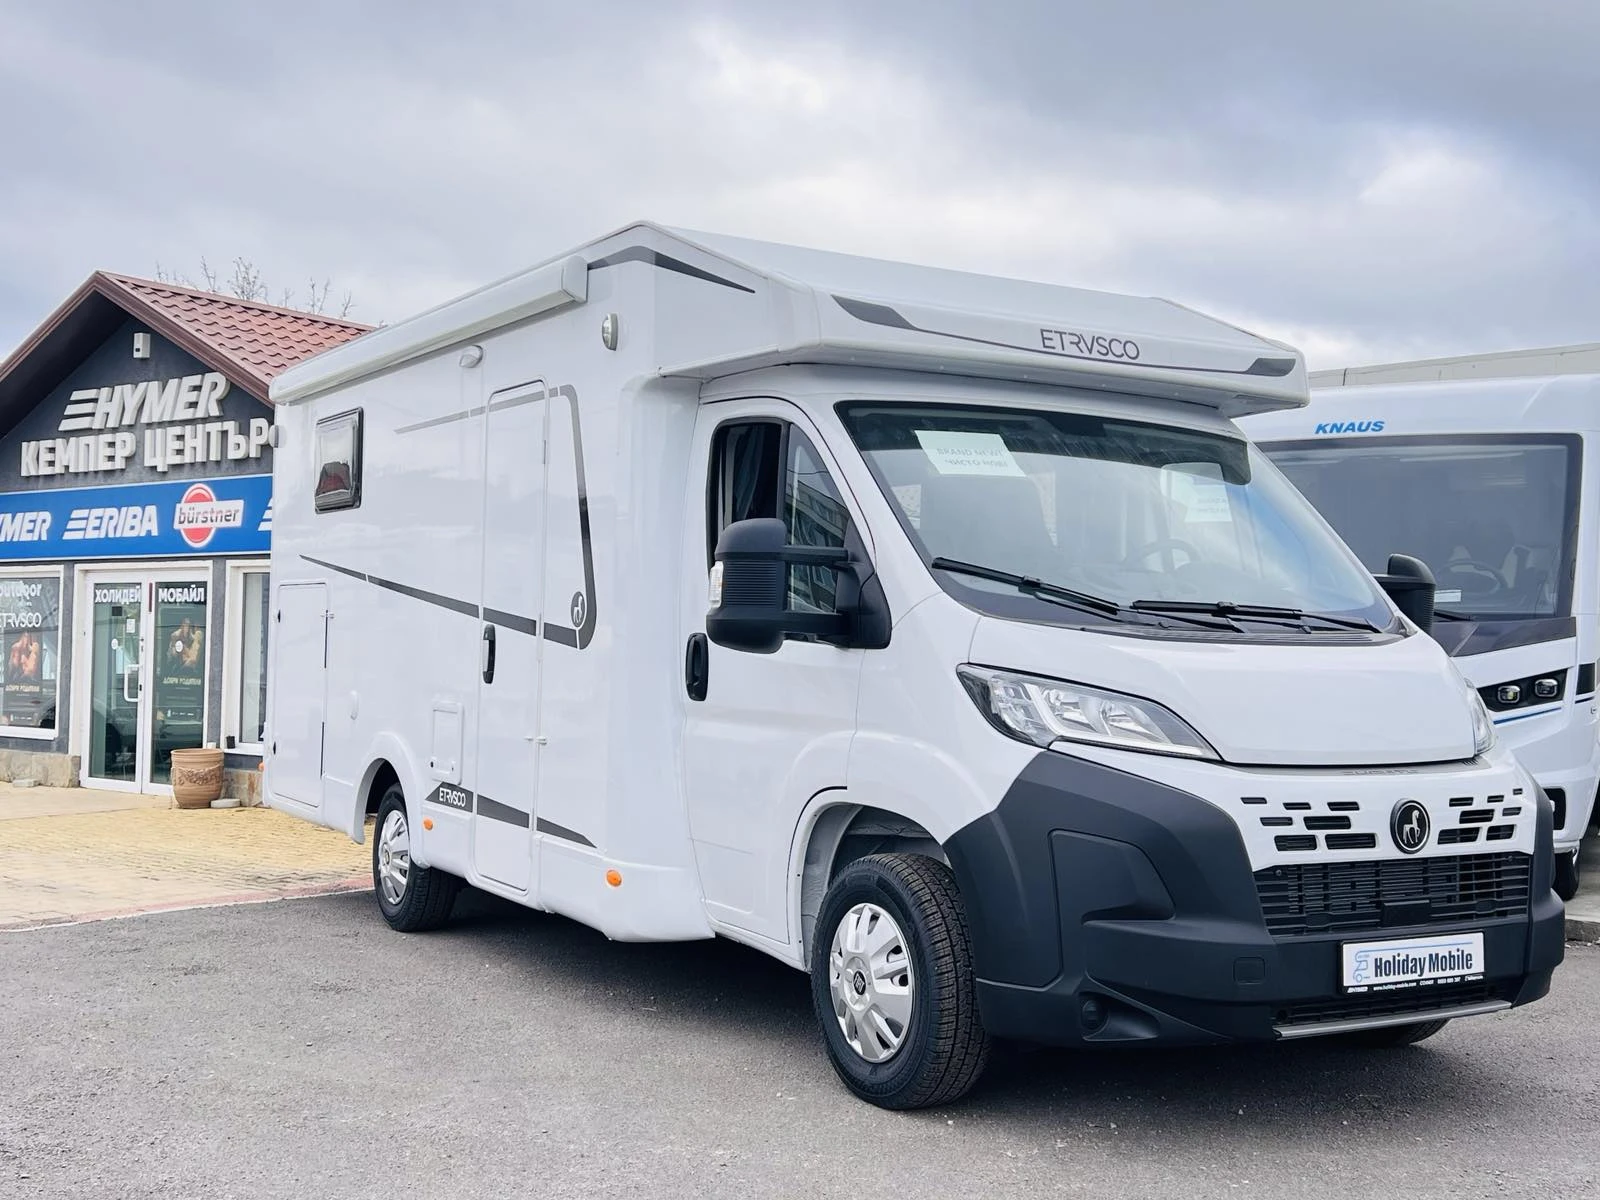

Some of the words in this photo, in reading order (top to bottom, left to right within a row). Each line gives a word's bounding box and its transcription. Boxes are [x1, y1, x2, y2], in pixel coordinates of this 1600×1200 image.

[1040, 328, 1140, 361] ETRVSCO
[91, 371, 231, 430] HYMER
[1314, 420, 1386, 435] KNAUS
[20, 431, 136, 477] КЕМПЕР
[143, 417, 270, 472] ЦЕНТЪР
[936, 447, 973, 457] BRAND
[83, 505, 159, 539] ERIBA
[177, 505, 241, 526] bürstner
[94, 585, 142, 605] ХОЛИДЕЙ
[158, 585, 205, 604] МОБАЙЛ
[439, 787, 466, 807] ETRVSCO
[1374, 952, 1427, 977] Holiday
[1428, 947, 1473, 973] Mobile
